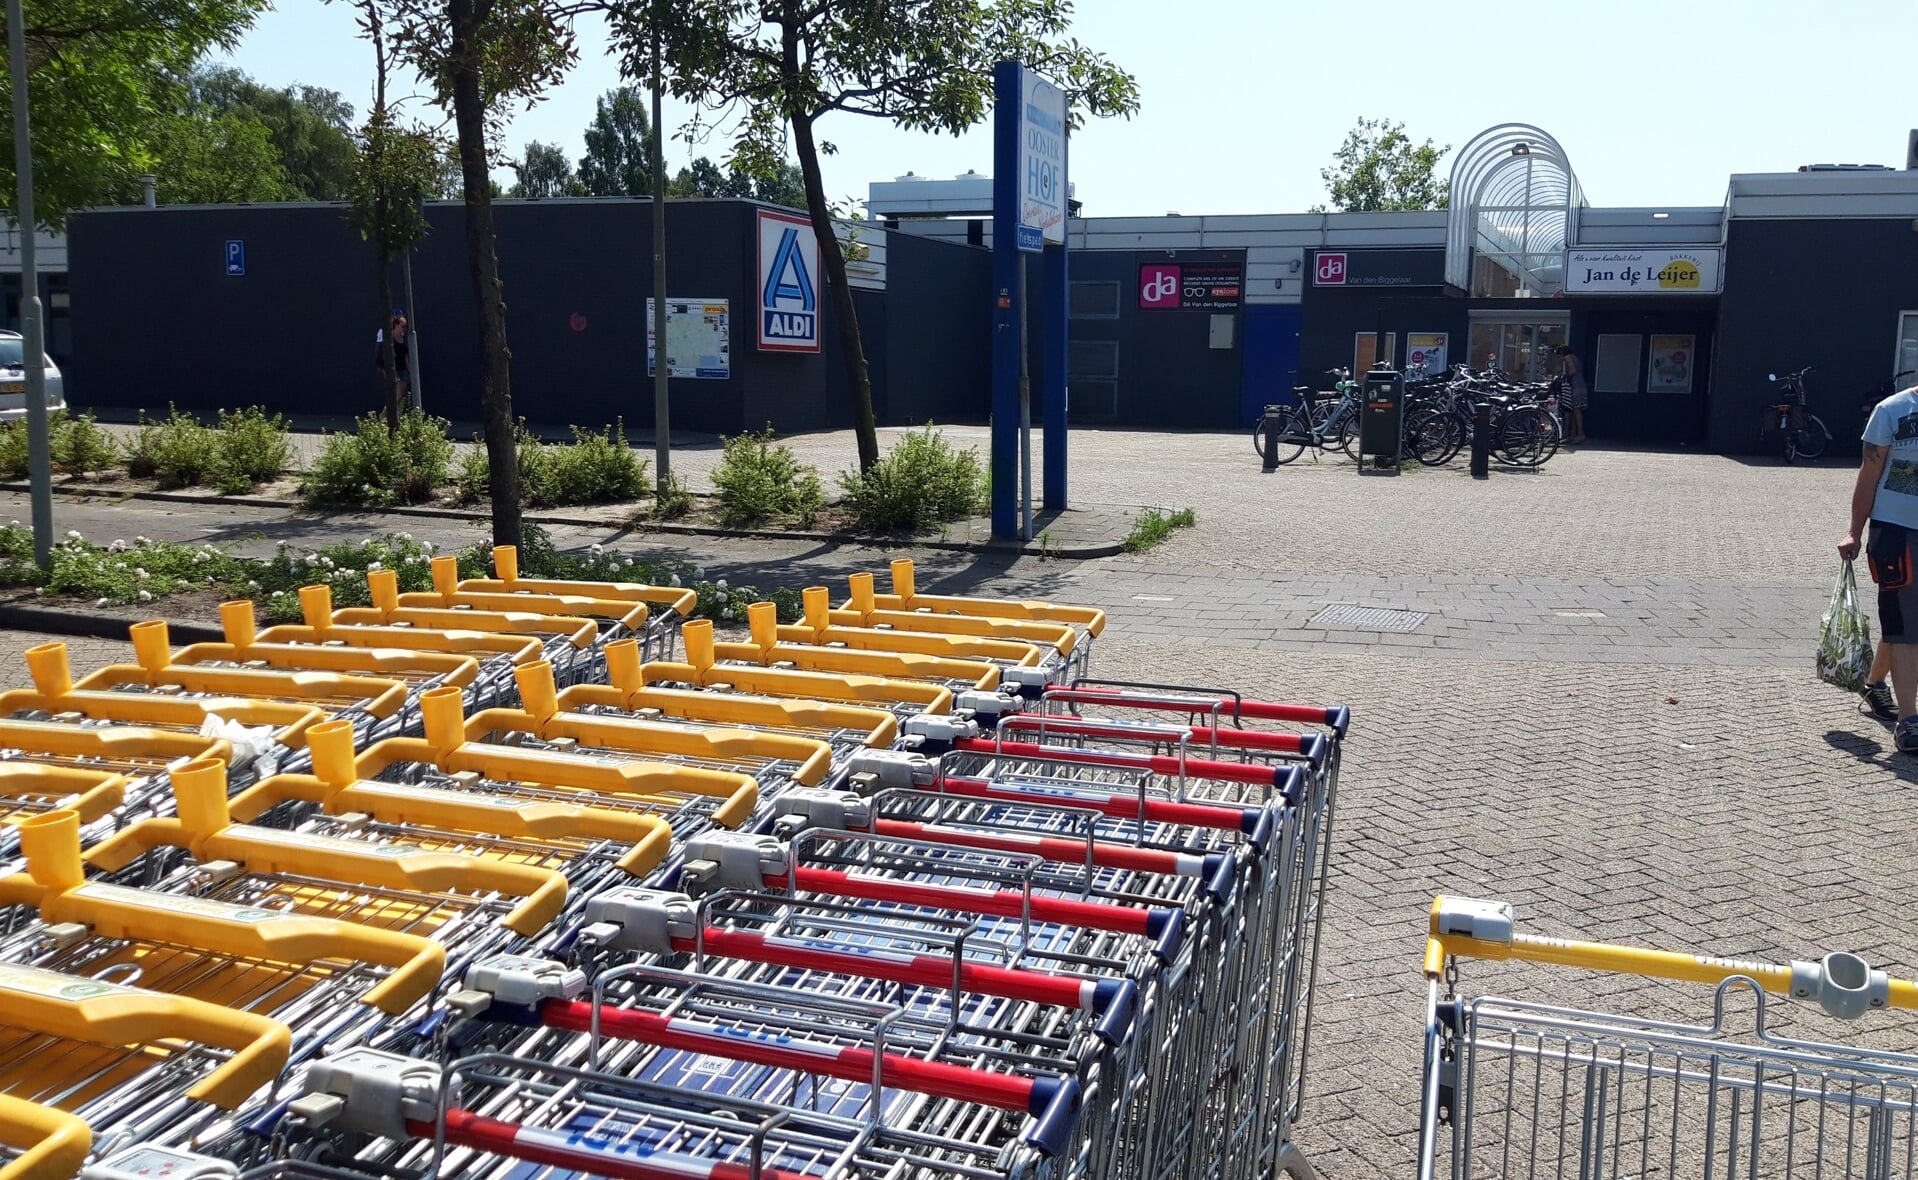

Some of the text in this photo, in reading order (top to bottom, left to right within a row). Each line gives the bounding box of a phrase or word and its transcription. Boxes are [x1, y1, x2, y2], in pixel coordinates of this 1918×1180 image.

[1028, 127, 1059, 160] OOSTER
[1028, 154, 1059, 203] HOF
[229, 243, 240, 261] P
[1573, 254, 1584, 262] Als
[1669, 253, 1701, 267] BAKKERIJ
[1319, 258, 1343, 279] da
[1583, 266, 1698, 284] Jan de Leijer
[1143, 271, 1177, 302] da
[1349, 276, 1362, 284] Van
[1363, 276, 1377, 284] den
[769, 313, 811, 338] ALDI
